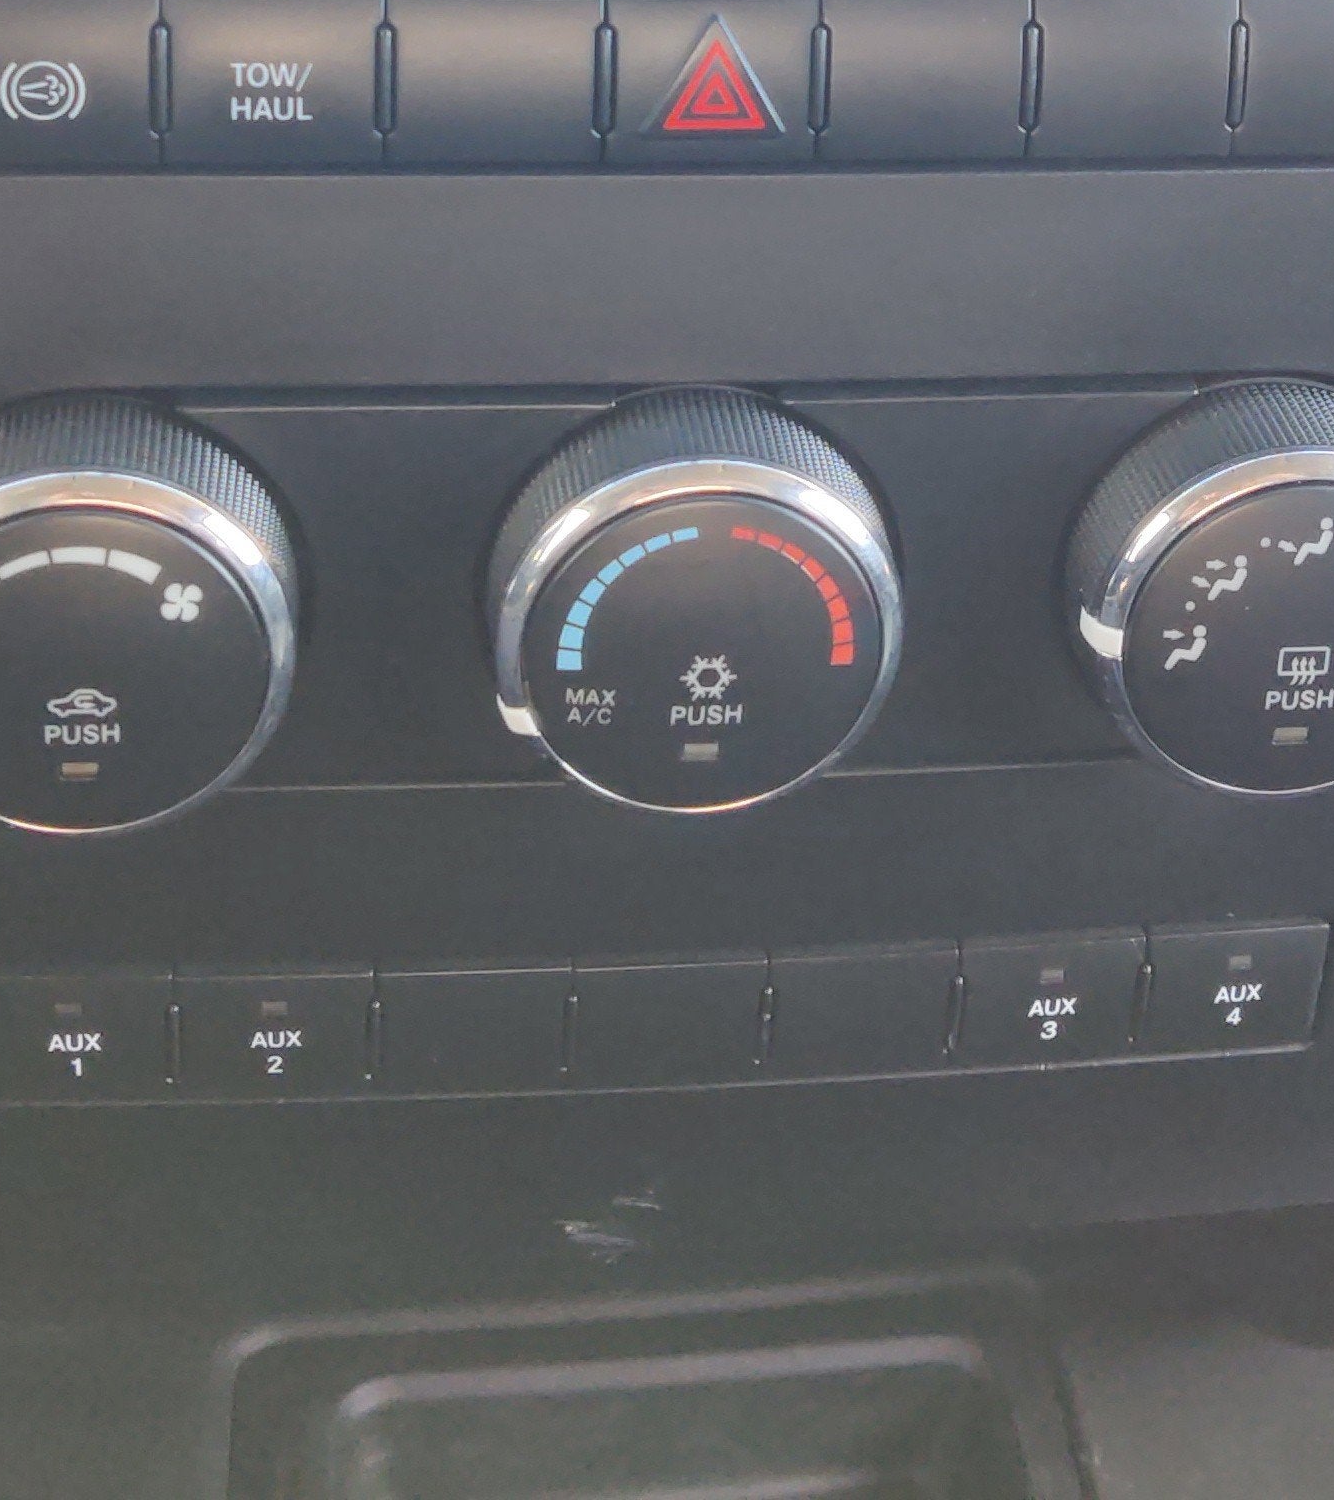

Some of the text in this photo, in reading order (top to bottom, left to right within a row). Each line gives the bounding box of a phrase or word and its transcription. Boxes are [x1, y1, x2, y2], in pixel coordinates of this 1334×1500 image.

[230, 62, 313, 92] TOW/
[230, 96, 314, 121] HAUL
[565, 687, 617, 709] MAX
[566, 706, 612, 727] A/C
[670, 703, 743, 726] PUSH
[43, 723, 122, 746] PUSH
[1213, 983, 1263, 1004] AUX
[1027, 997, 1078, 1018] AUX
[1225, 1006, 1242, 1025] 4
[250, 1030, 303, 1049] AUX
[1040, 1020, 1058, 1040] 3
[48, 1032, 102, 1052] AUX
[71, 1057, 82, 1077] 1
[267, 1055, 284, 1074] 2
